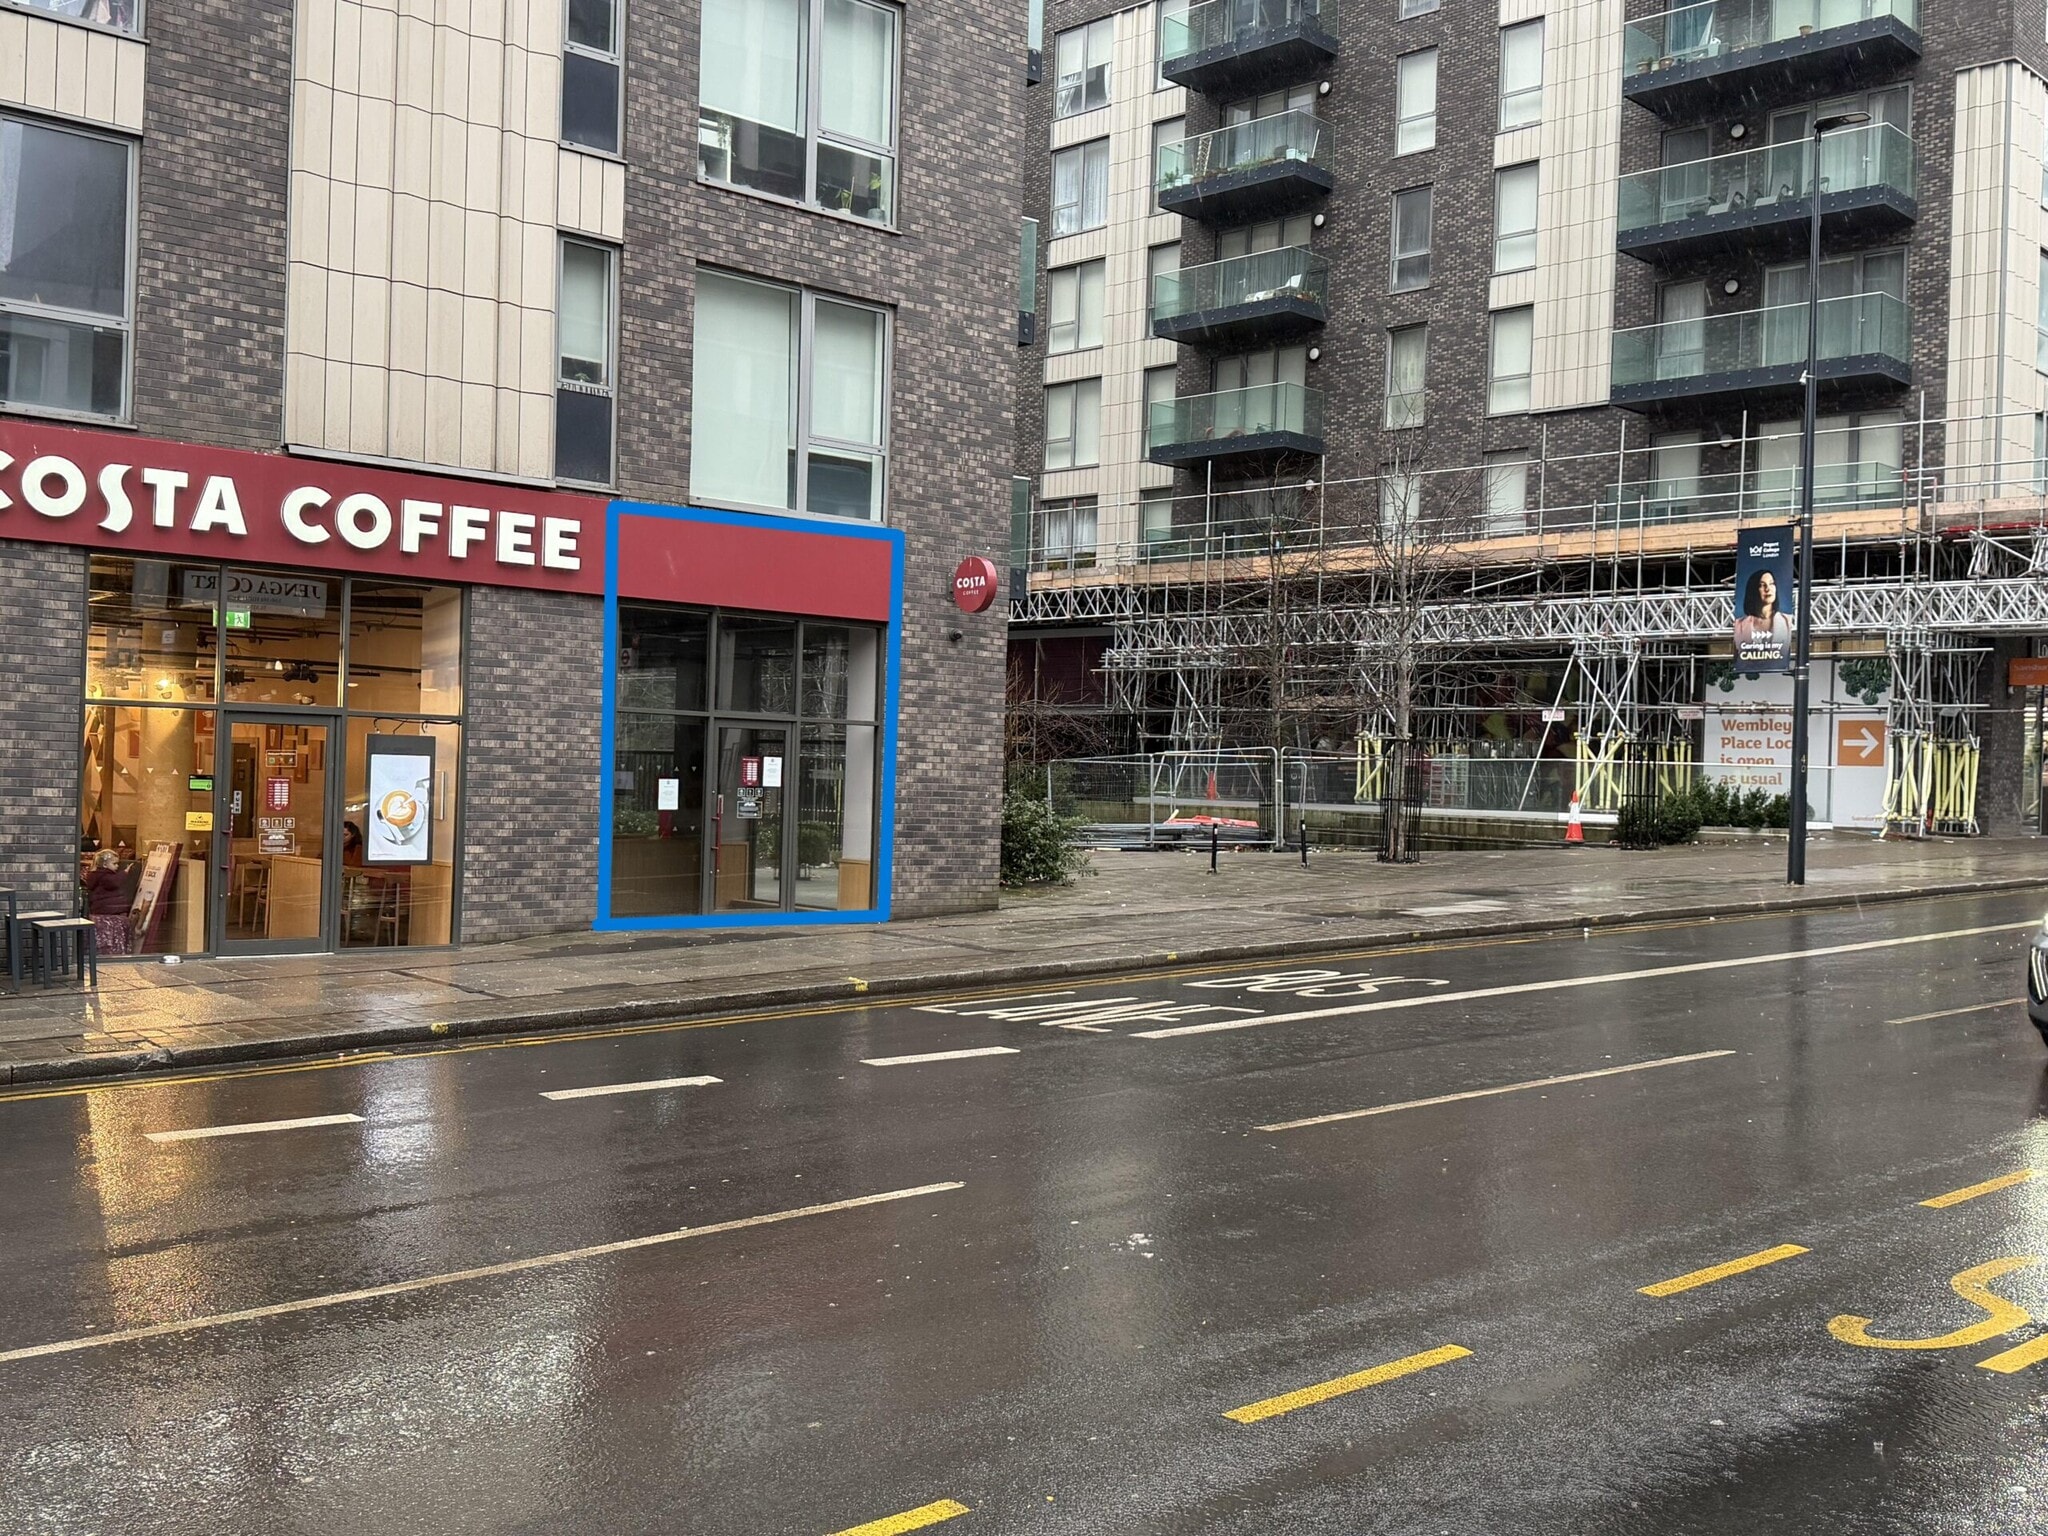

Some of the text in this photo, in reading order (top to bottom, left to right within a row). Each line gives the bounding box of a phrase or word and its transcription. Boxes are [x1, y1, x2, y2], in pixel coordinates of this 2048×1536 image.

[0, 451, 581, 570] OSTA COFFEE
[956, 575, 986, 589] COSTA
[1740, 641, 1784, 651] Caring is my
[1740, 650, 1784, 660] CALLING.
[1721, 718, 1792, 735] Wembley
[1721, 736, 1793, 749] Place Loc
[1720, 753, 1775, 770] is open
[1720, 772, 1783, 785] as usual
[1182, 969, 1450, 997] BUS
